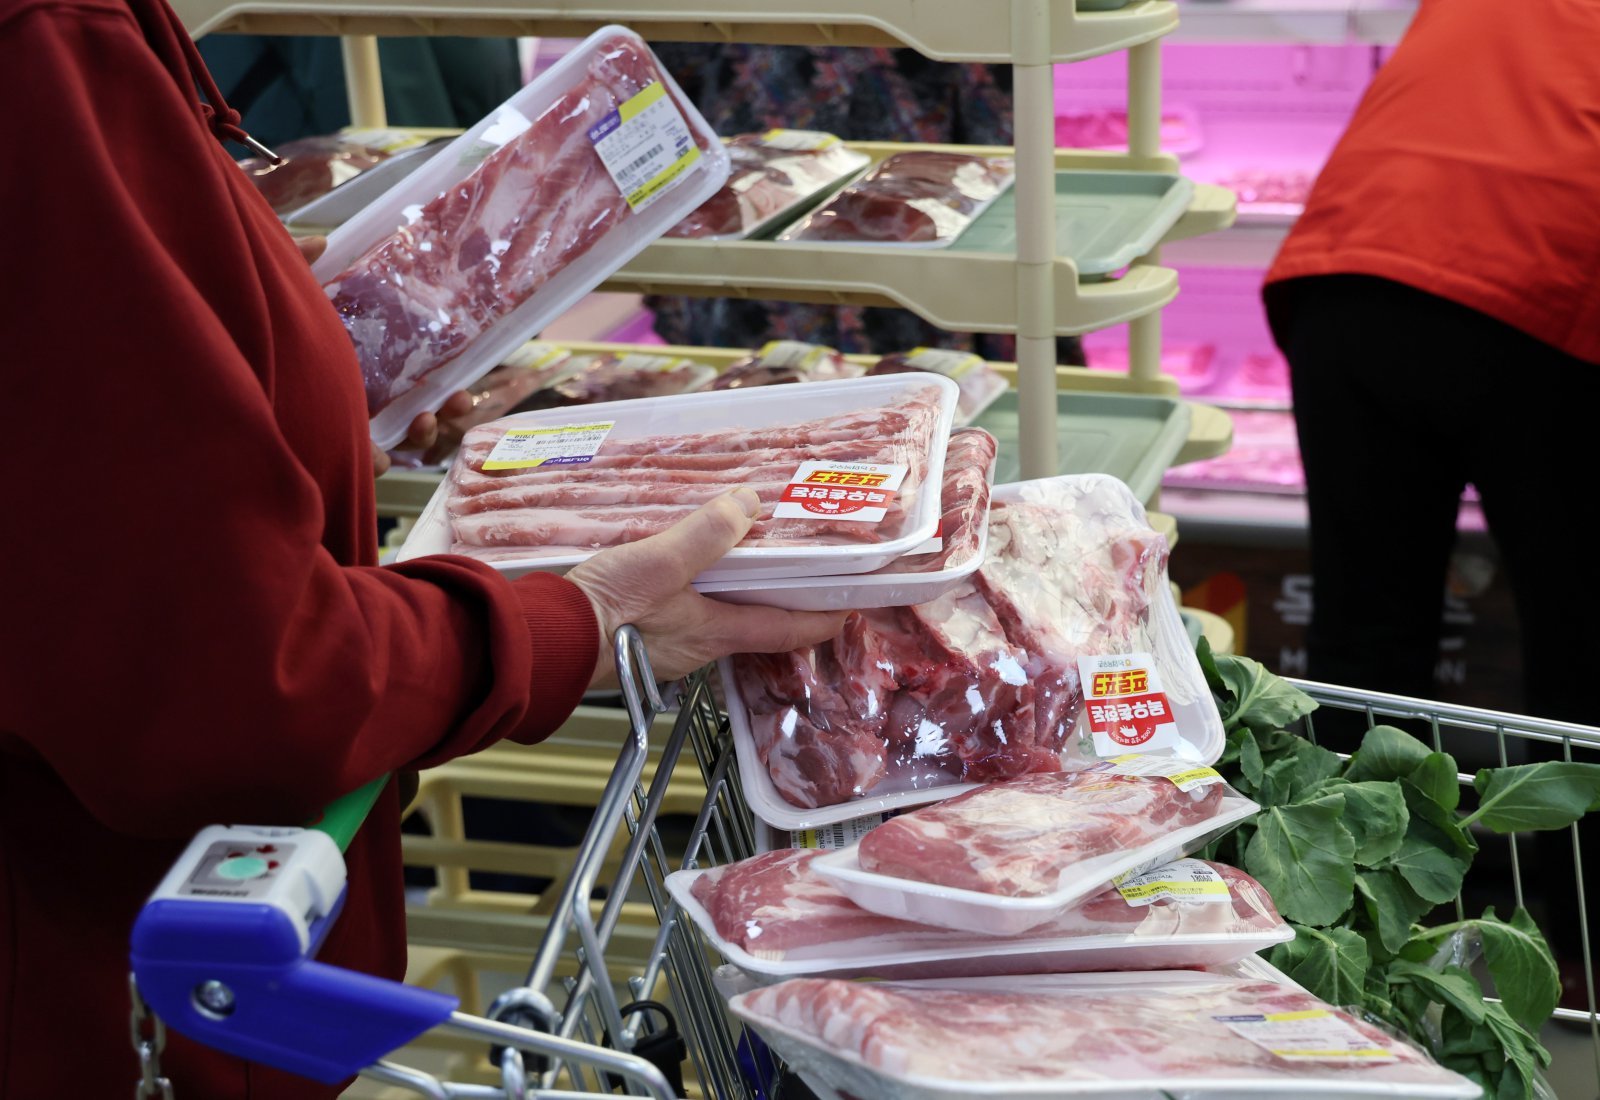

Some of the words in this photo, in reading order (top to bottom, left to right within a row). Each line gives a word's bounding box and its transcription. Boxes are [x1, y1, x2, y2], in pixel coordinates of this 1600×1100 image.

[804, 470, 890, 487] 프로포크
[791, 487, 886, 503] 목우촌한돈
[1092, 670, 1148, 697] 프로포크
[1090, 699, 1166, 725] 목우촌한돈
